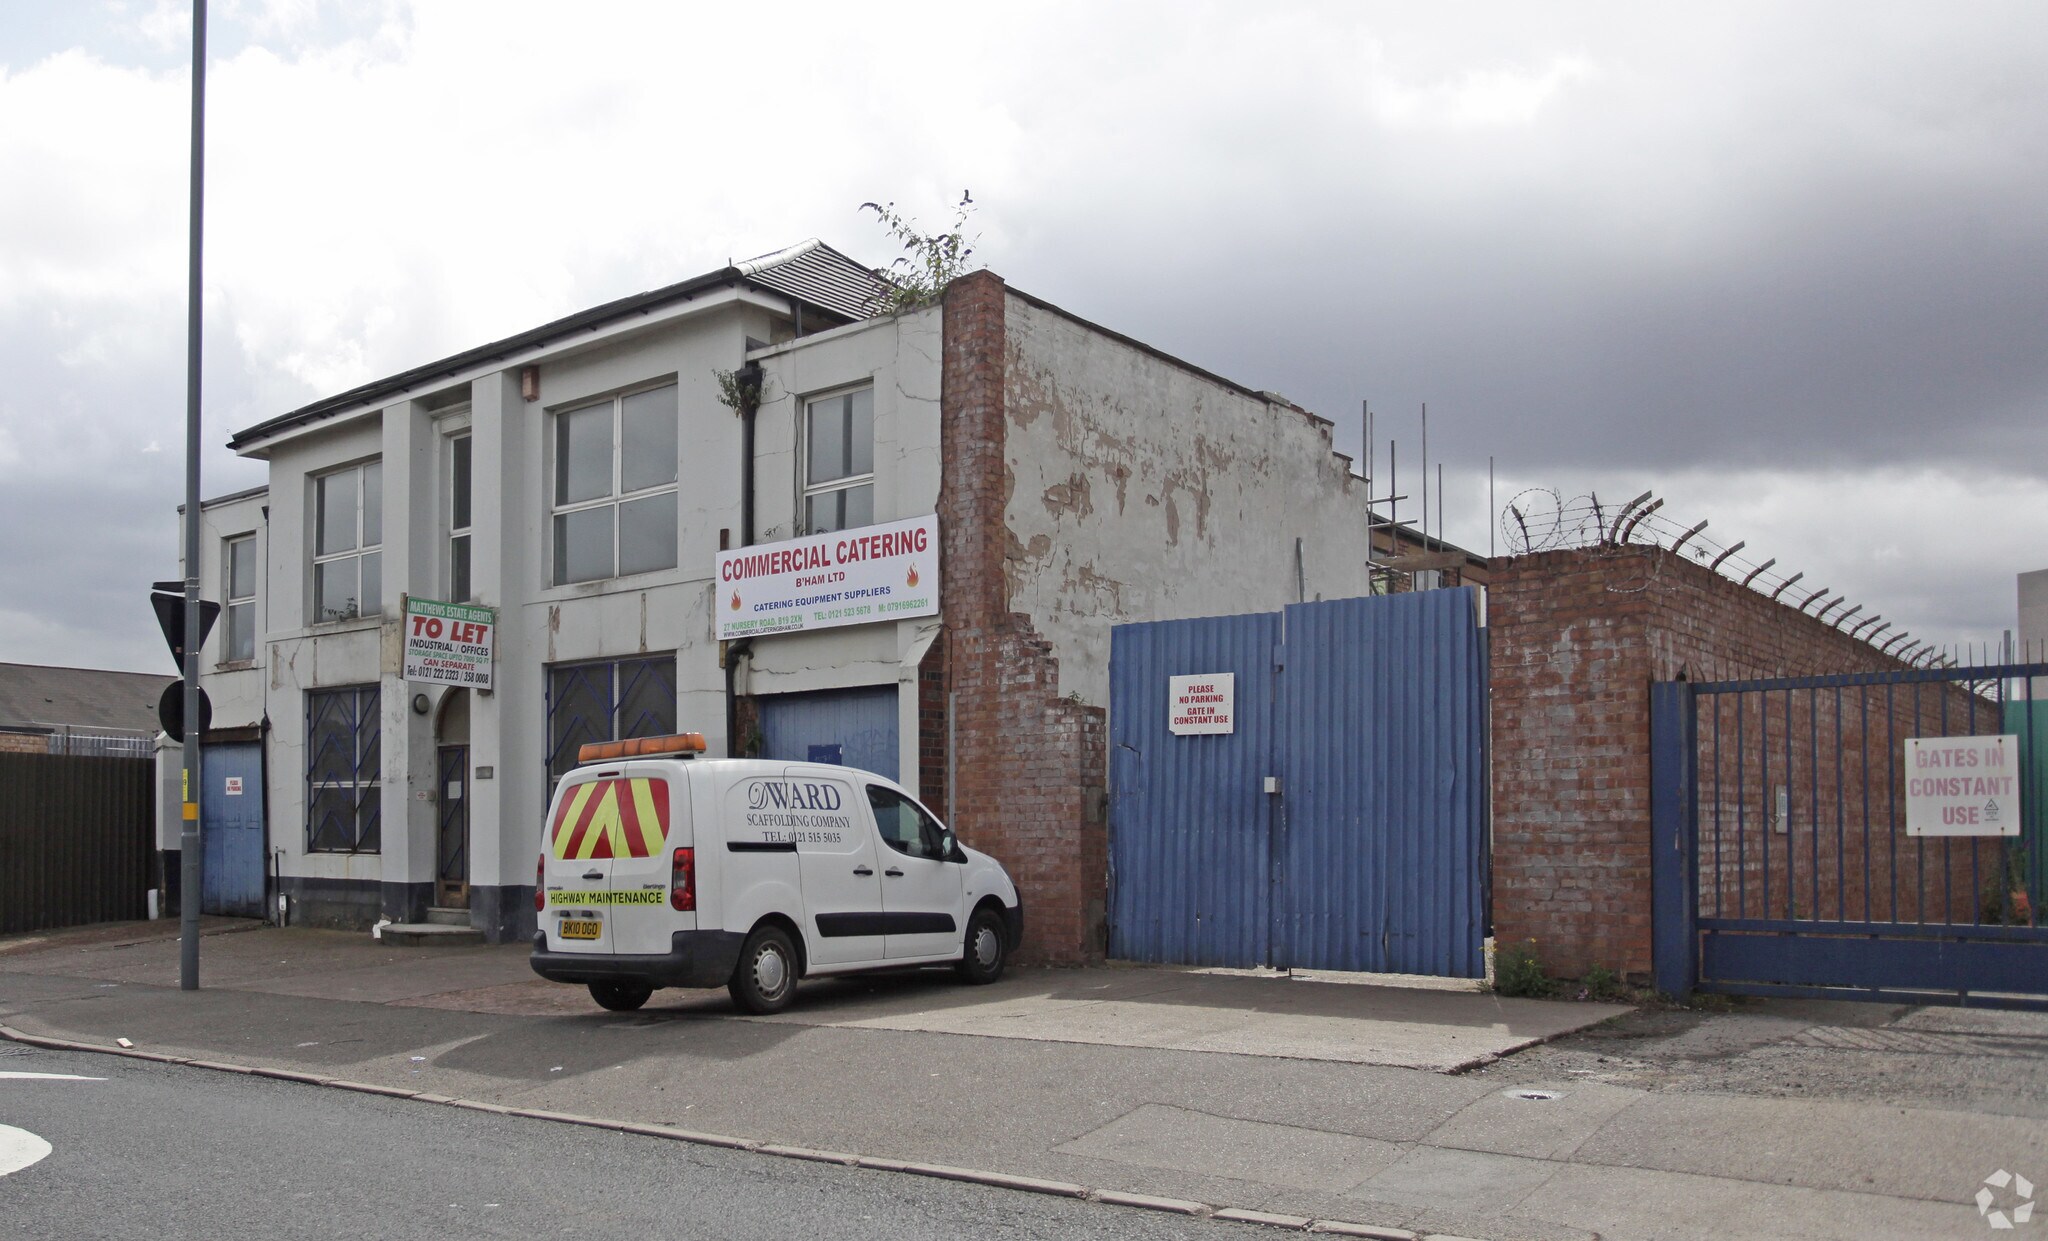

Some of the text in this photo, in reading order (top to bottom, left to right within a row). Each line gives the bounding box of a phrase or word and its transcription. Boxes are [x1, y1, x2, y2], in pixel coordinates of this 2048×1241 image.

[722, 527, 927, 582] COMMERCIAL CATERING
[828, 572, 845, 583] LTD
[754, 586, 891, 612] CATERING EQUIPMENT SUPPLIERS
[409, 600, 492, 622] MATTHEWS ESTATE AGENTS
[814, 606, 871, 620] TEL: 0121 523 5678
[413, 616, 488, 644] TO LET
[732, 620, 758, 630] NURSERY
[778, 616, 788, 624] B19
[408, 648, 432, 658] STORAGE
[432, 652, 448, 660] SPACE
[410, 638, 453, 652] INDUSTRIAL
[460, 645, 488, 656] OFFICES
[423, 658, 475, 671] CAN SEPARATE
[407, 665, 416, 676] Tel:
[418, 666, 432, 678] 0121
[434, 668, 444, 679] 222
[445, 669, 459, 680] 2323
[464, 672, 474, 682] 358
[1188, 684, 1214, 694] PLEASE
[1179, 694, 1224, 704] NO PARKING
[1187, 706, 1214, 716] GATE IN
[1174, 715, 1228, 725] CONSTANT USE
[1916, 748, 2004, 768] GATES IN
[1910, 776, 2013, 797] CONSTANT
[746, 814, 850, 828] SCAFFOLDING COMPANY
[1942, 806, 1980, 825] USE
[762, 832, 842, 843] TEL: 0121 515 5035
[550, 892, 662, 904] HIGHWAY MAINTENANCE
[564, 922, 580, 935] BK10
